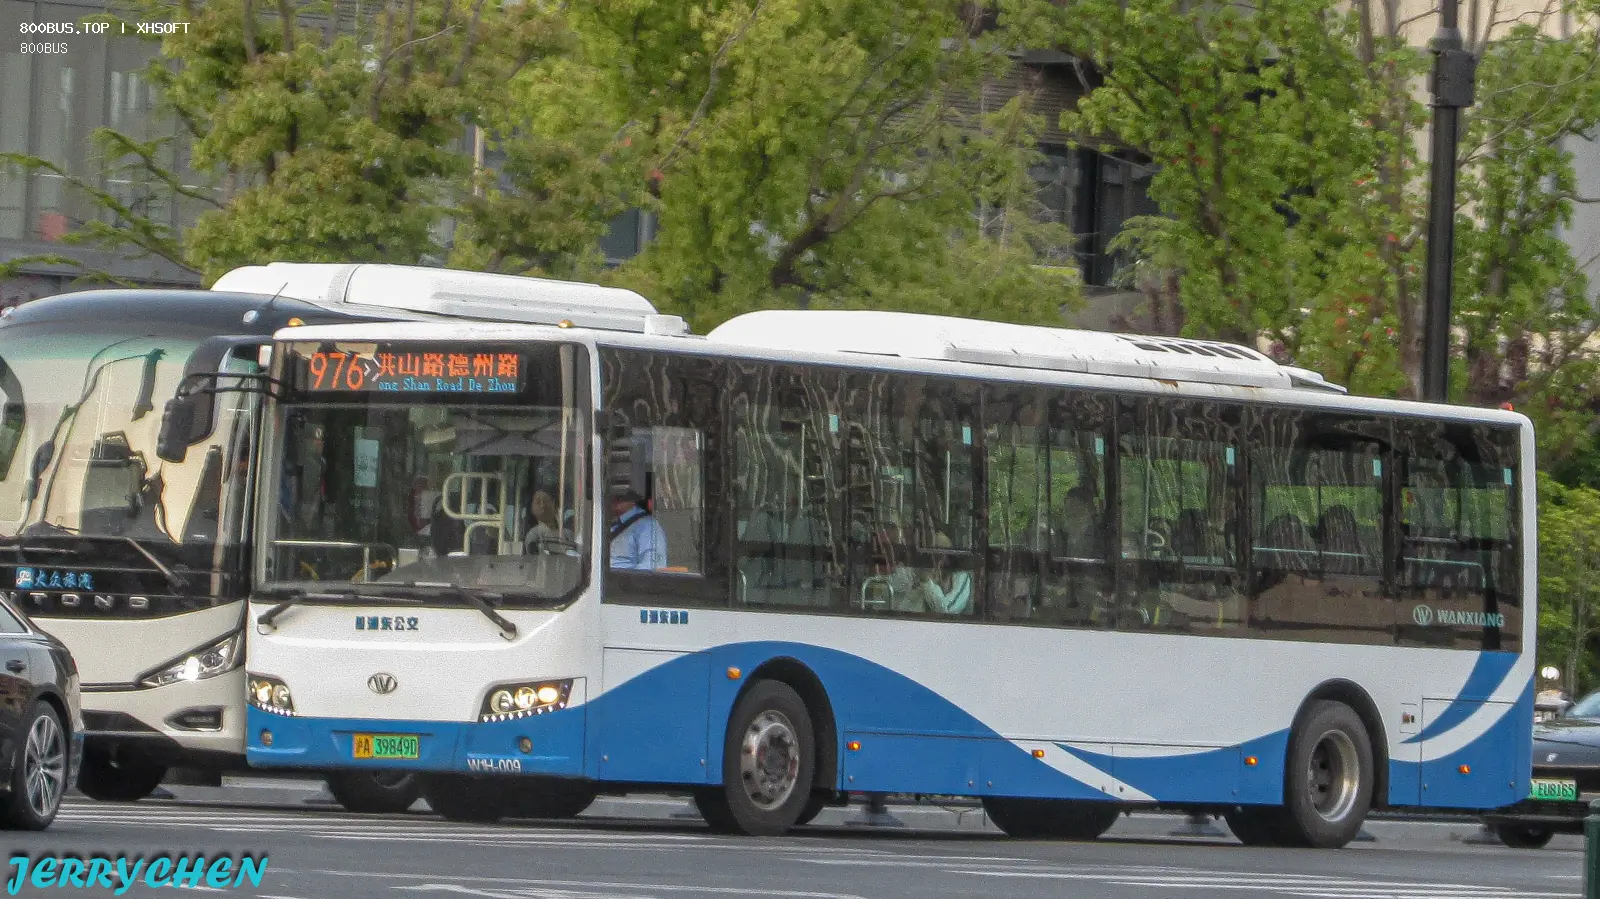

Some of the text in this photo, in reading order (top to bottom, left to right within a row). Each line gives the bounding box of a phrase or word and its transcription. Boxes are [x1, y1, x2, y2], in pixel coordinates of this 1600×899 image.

[310, 352, 365, 390] 976
[403, 377, 430, 391] Shan
[436, 378, 463, 391] Road
[468, 379, 482, 391] De
[487, 377, 517, 391] Zhou
[1437, 609, 1505, 627] WANXIANG
